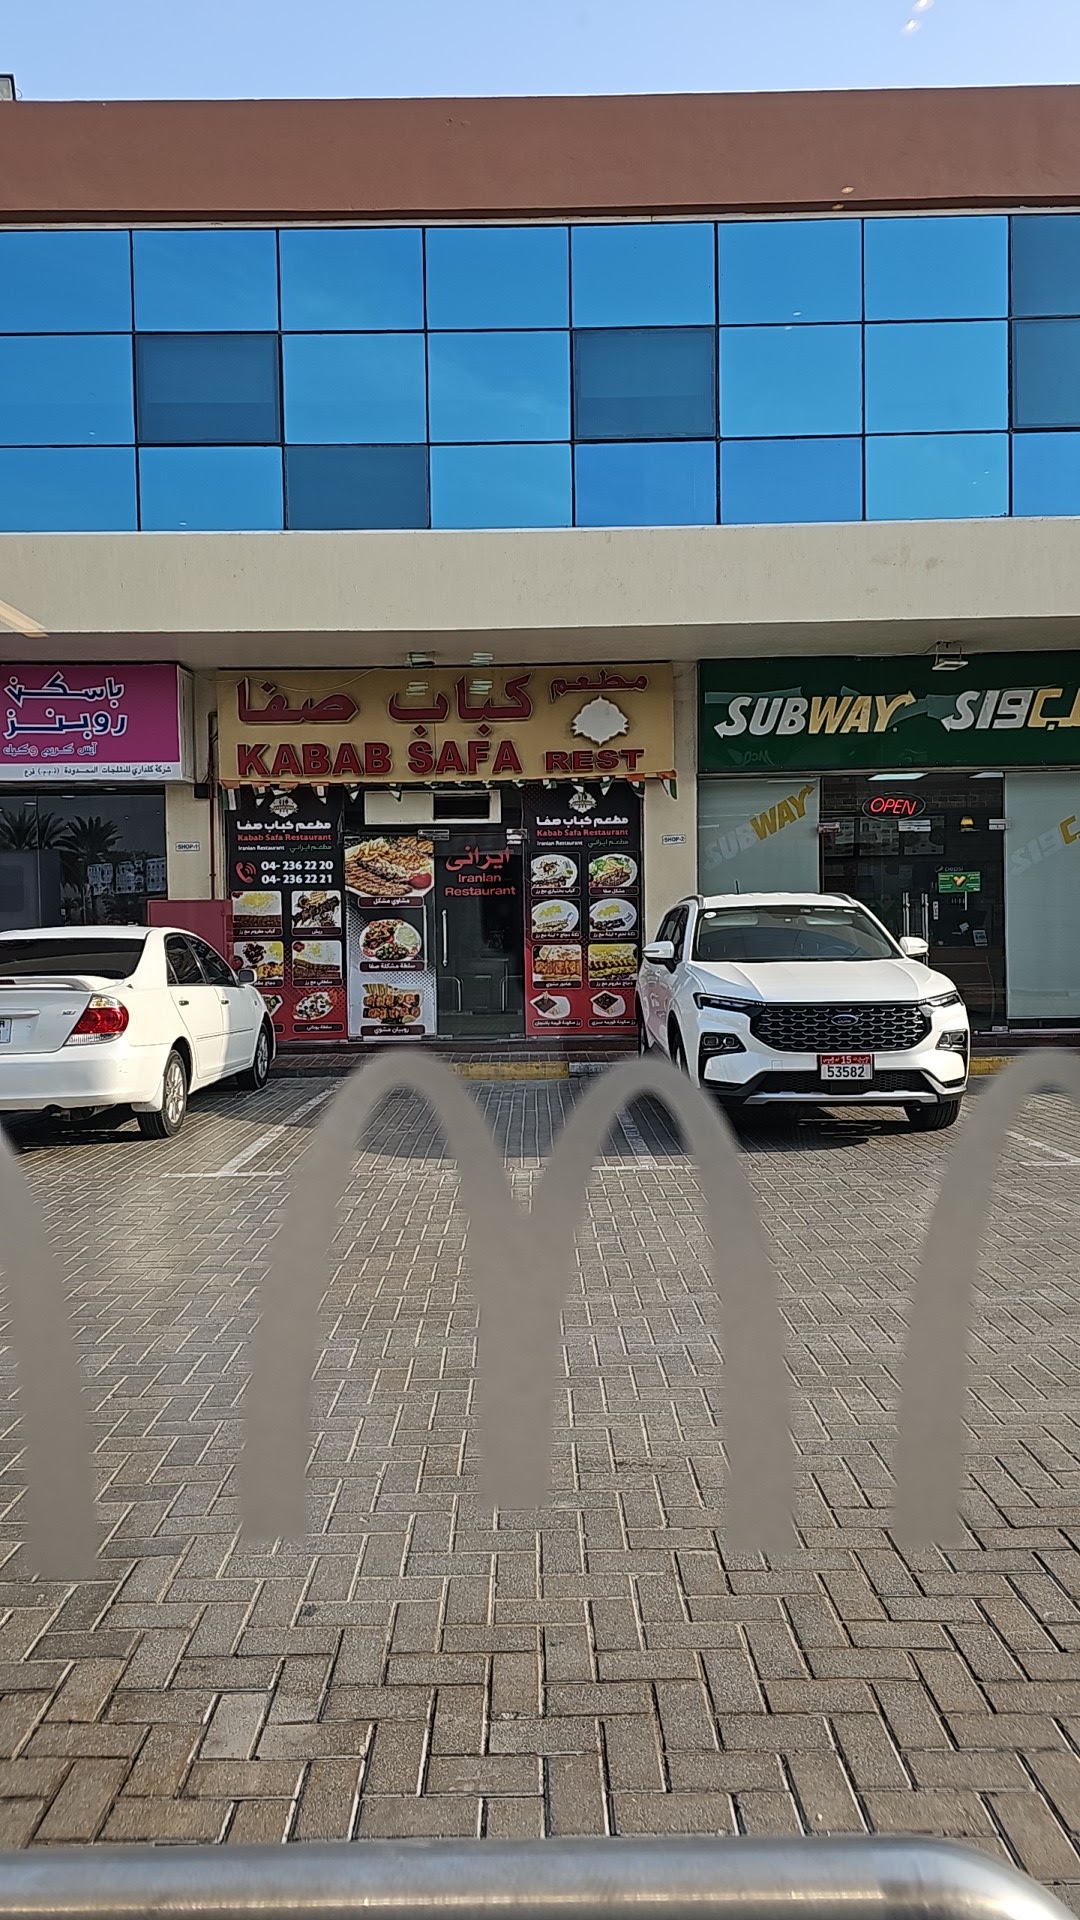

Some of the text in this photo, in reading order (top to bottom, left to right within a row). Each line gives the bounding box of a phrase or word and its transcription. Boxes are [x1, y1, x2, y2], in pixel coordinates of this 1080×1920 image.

[549, 669, 649, 703] مطعم
[235, 672, 534, 738] كباب صفا
[713, 690, 917, 739] SUBWAY
[3, 708, 128, 739] روبنز
[41, 742, 75, 757] كريم
[236, 740, 523, 776] KABAB SAFA
[544, 748, 646, 772] REST
[870, 797, 917, 815] OPEN
[236, 820, 332, 833] مطعم كباب صفا
[536, 815, 629, 828] مطعم كباب صفا
[537, 829, 563, 837] Kabab
[261, 861, 334, 870] 04- 236 22 20
[261, 875, 332, 884] 04- 236 22 21
[458, 873, 501, 883] Iranian
[445, 886, 516, 896] Restaurant
[841, 1056, 852, 1064] 15
[827, 1066, 865, 1078] 53582
